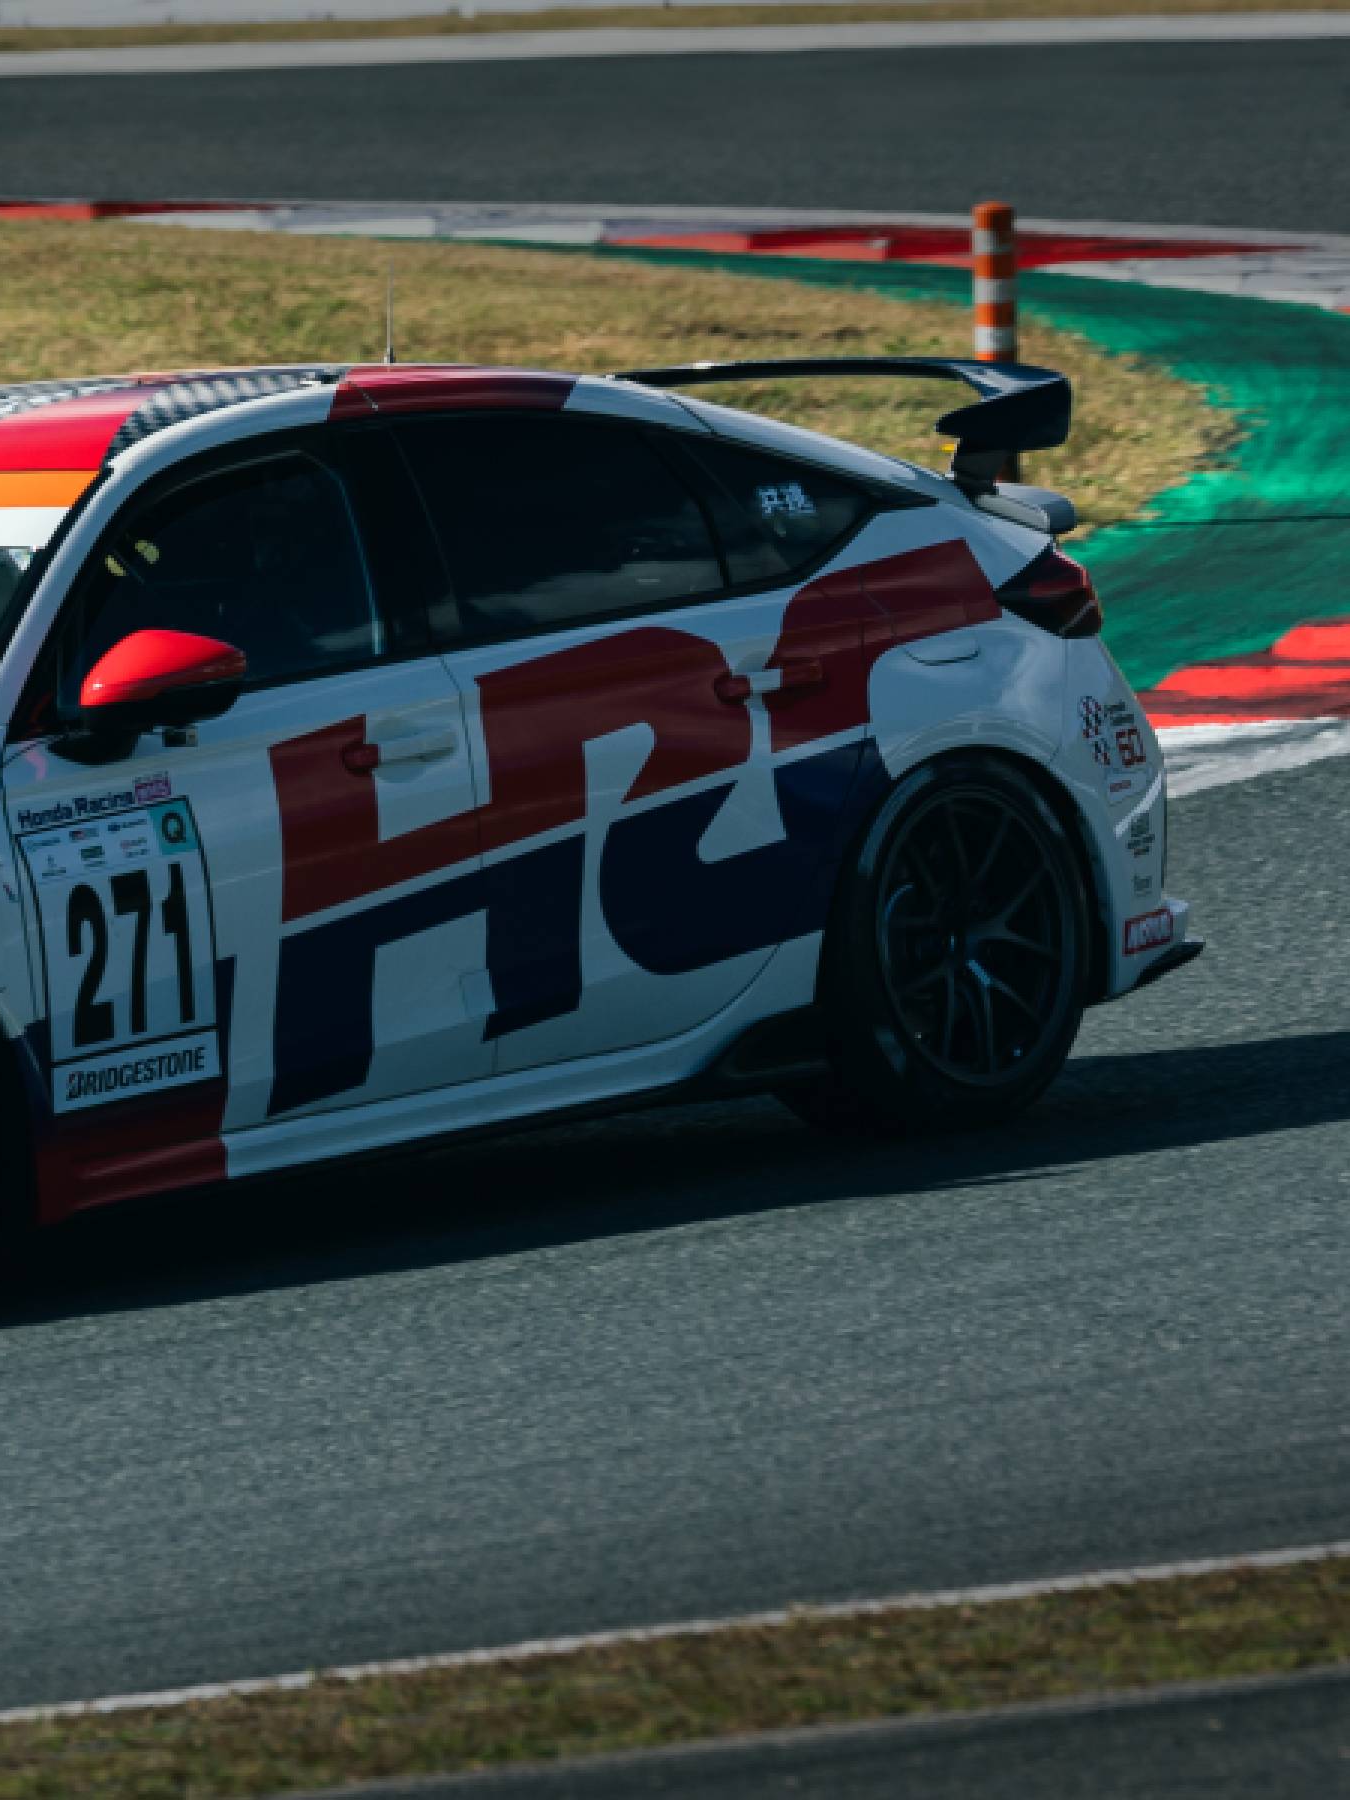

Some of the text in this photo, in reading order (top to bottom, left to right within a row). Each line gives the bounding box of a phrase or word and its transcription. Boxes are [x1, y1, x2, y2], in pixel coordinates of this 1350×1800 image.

[18, 791, 133, 828] Honda Racing
[161, 811, 186, 844] Q
[268, 538, 1002, 1118] HRC
[67, 863, 195, 1046] 271
[66, 1048, 206, 1100] BRIDGESTONE
